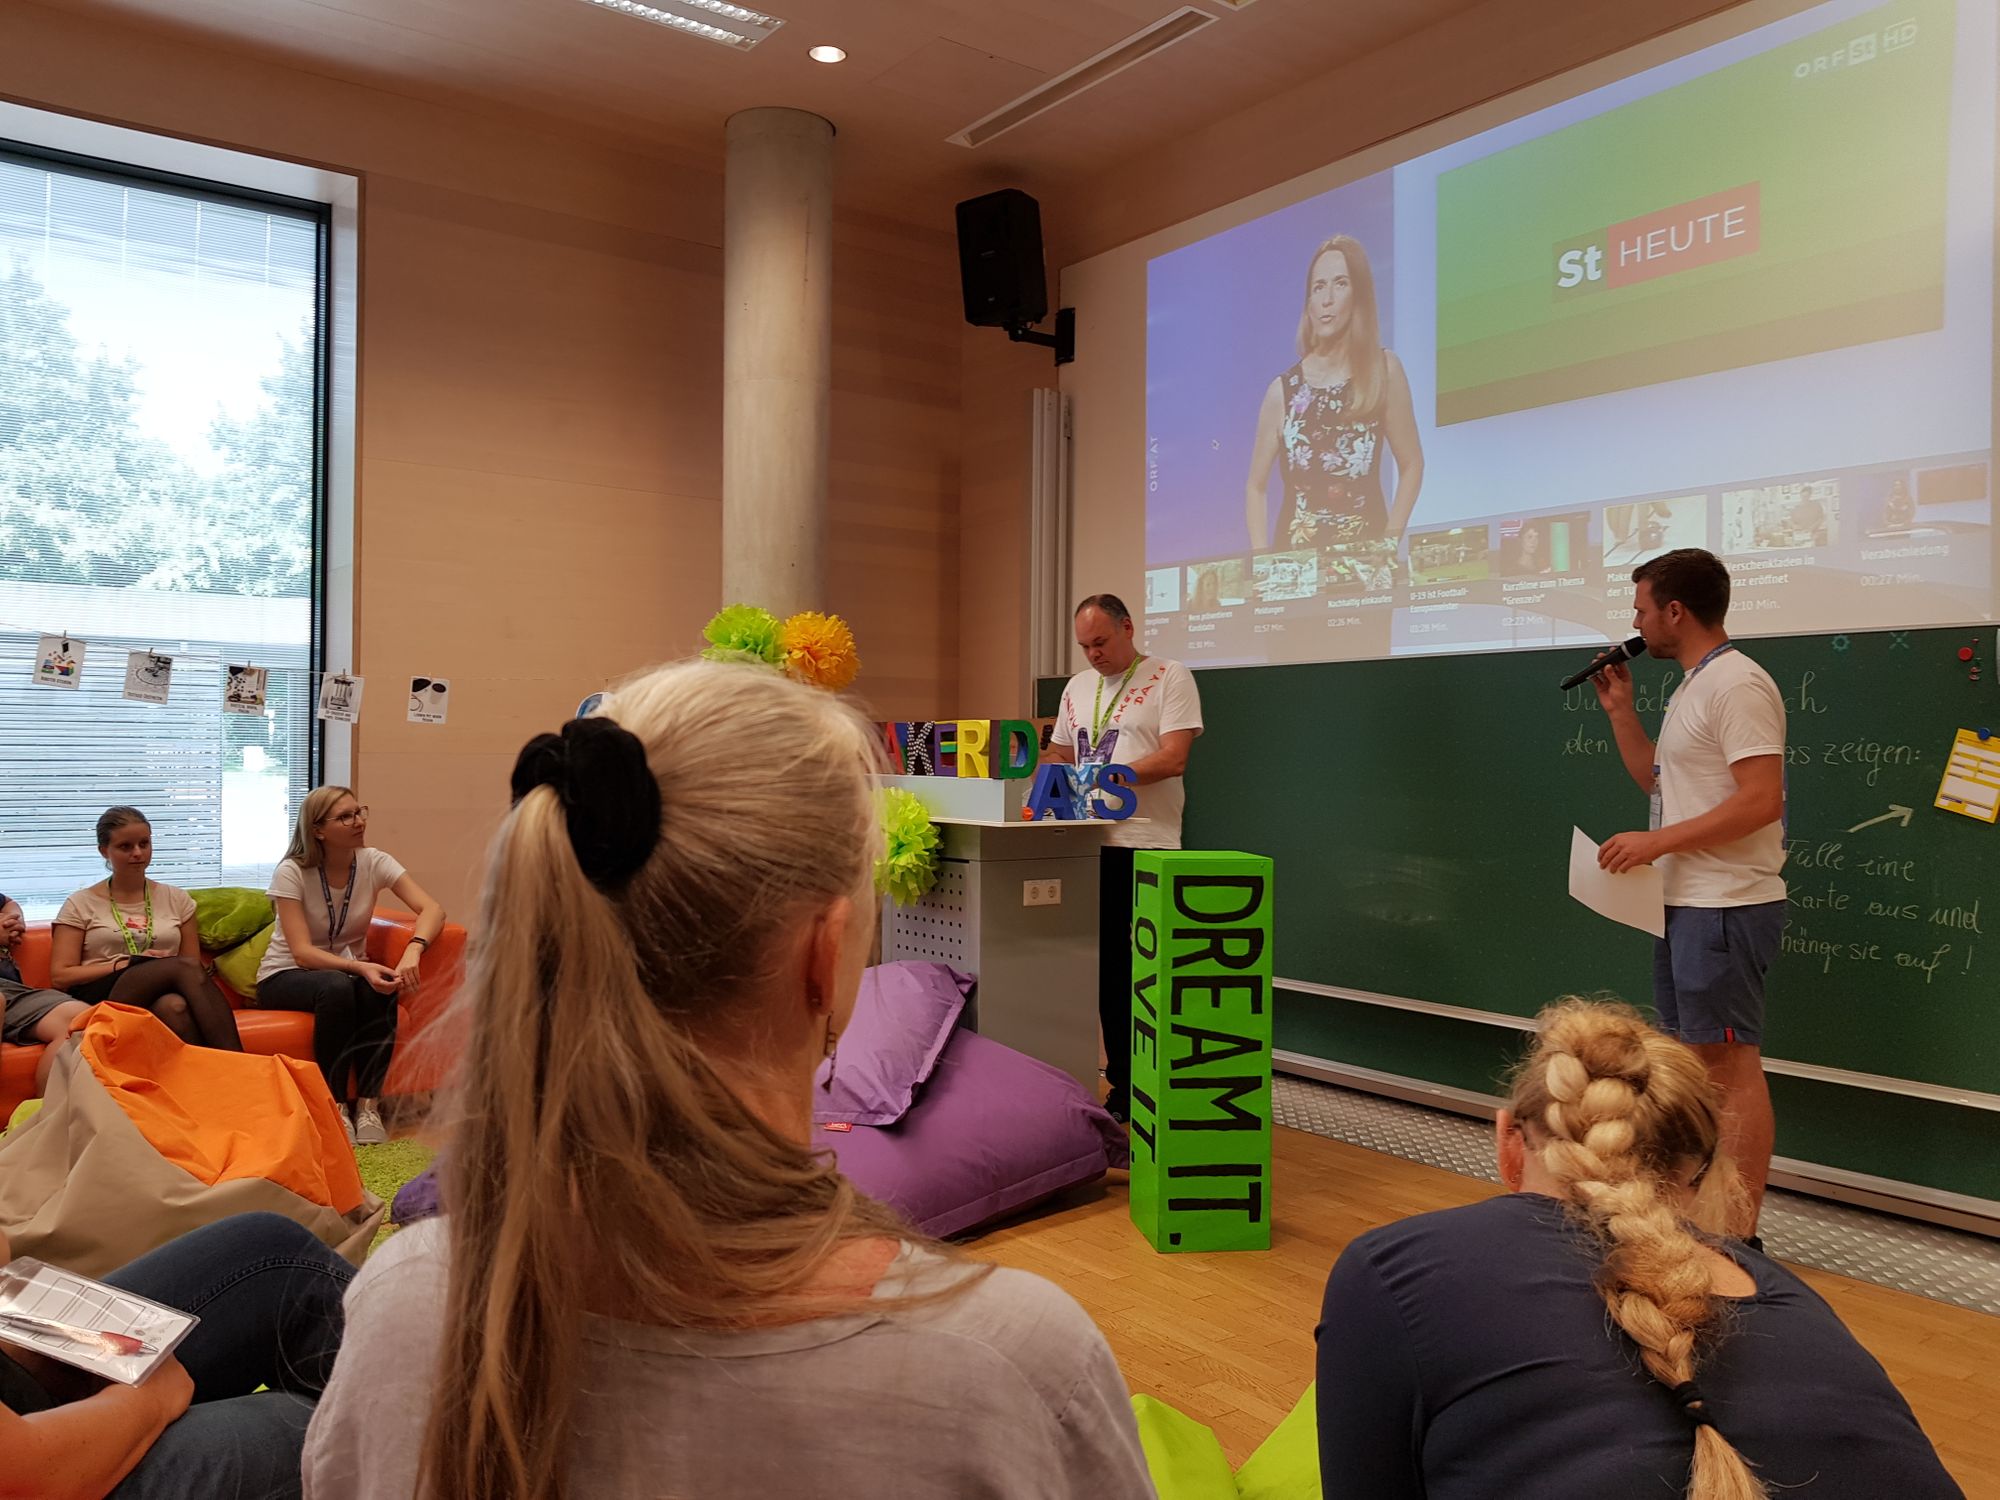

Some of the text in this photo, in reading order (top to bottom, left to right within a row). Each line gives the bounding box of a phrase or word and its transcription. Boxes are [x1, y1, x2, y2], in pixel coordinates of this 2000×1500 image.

[1794, 49, 1846, 79] ORF
[1883, 22, 1918, 50] HD
[1557, 205, 1747, 288] St HEUTE
[1861, 544, 1949, 561] Verabschiedung
[1540, 579, 1556, 588] zum
[1558, 577, 1585, 588] Thema
[1607, 589, 1622, 598] der
[1748, 573, 1789, 586] eröffnet
[1730, 598, 1781, 612] 2:10 Min.
[1784, 670, 1828, 714] ch
[1561, 723, 1608, 755] den
[1823, 737, 1921, 787] zeigen:
[1857, 856, 1915, 882] eine
[1864, 902, 1920, 920] aus
[1928, 898, 1983, 934] und
[1849, 941, 1882, 961] sie
[1894, 943, 1951, 984] auf
[1131, 869, 1159, 1166] LOVE IT.
[1168, 874, 1265, 1247] DREAM IT.
